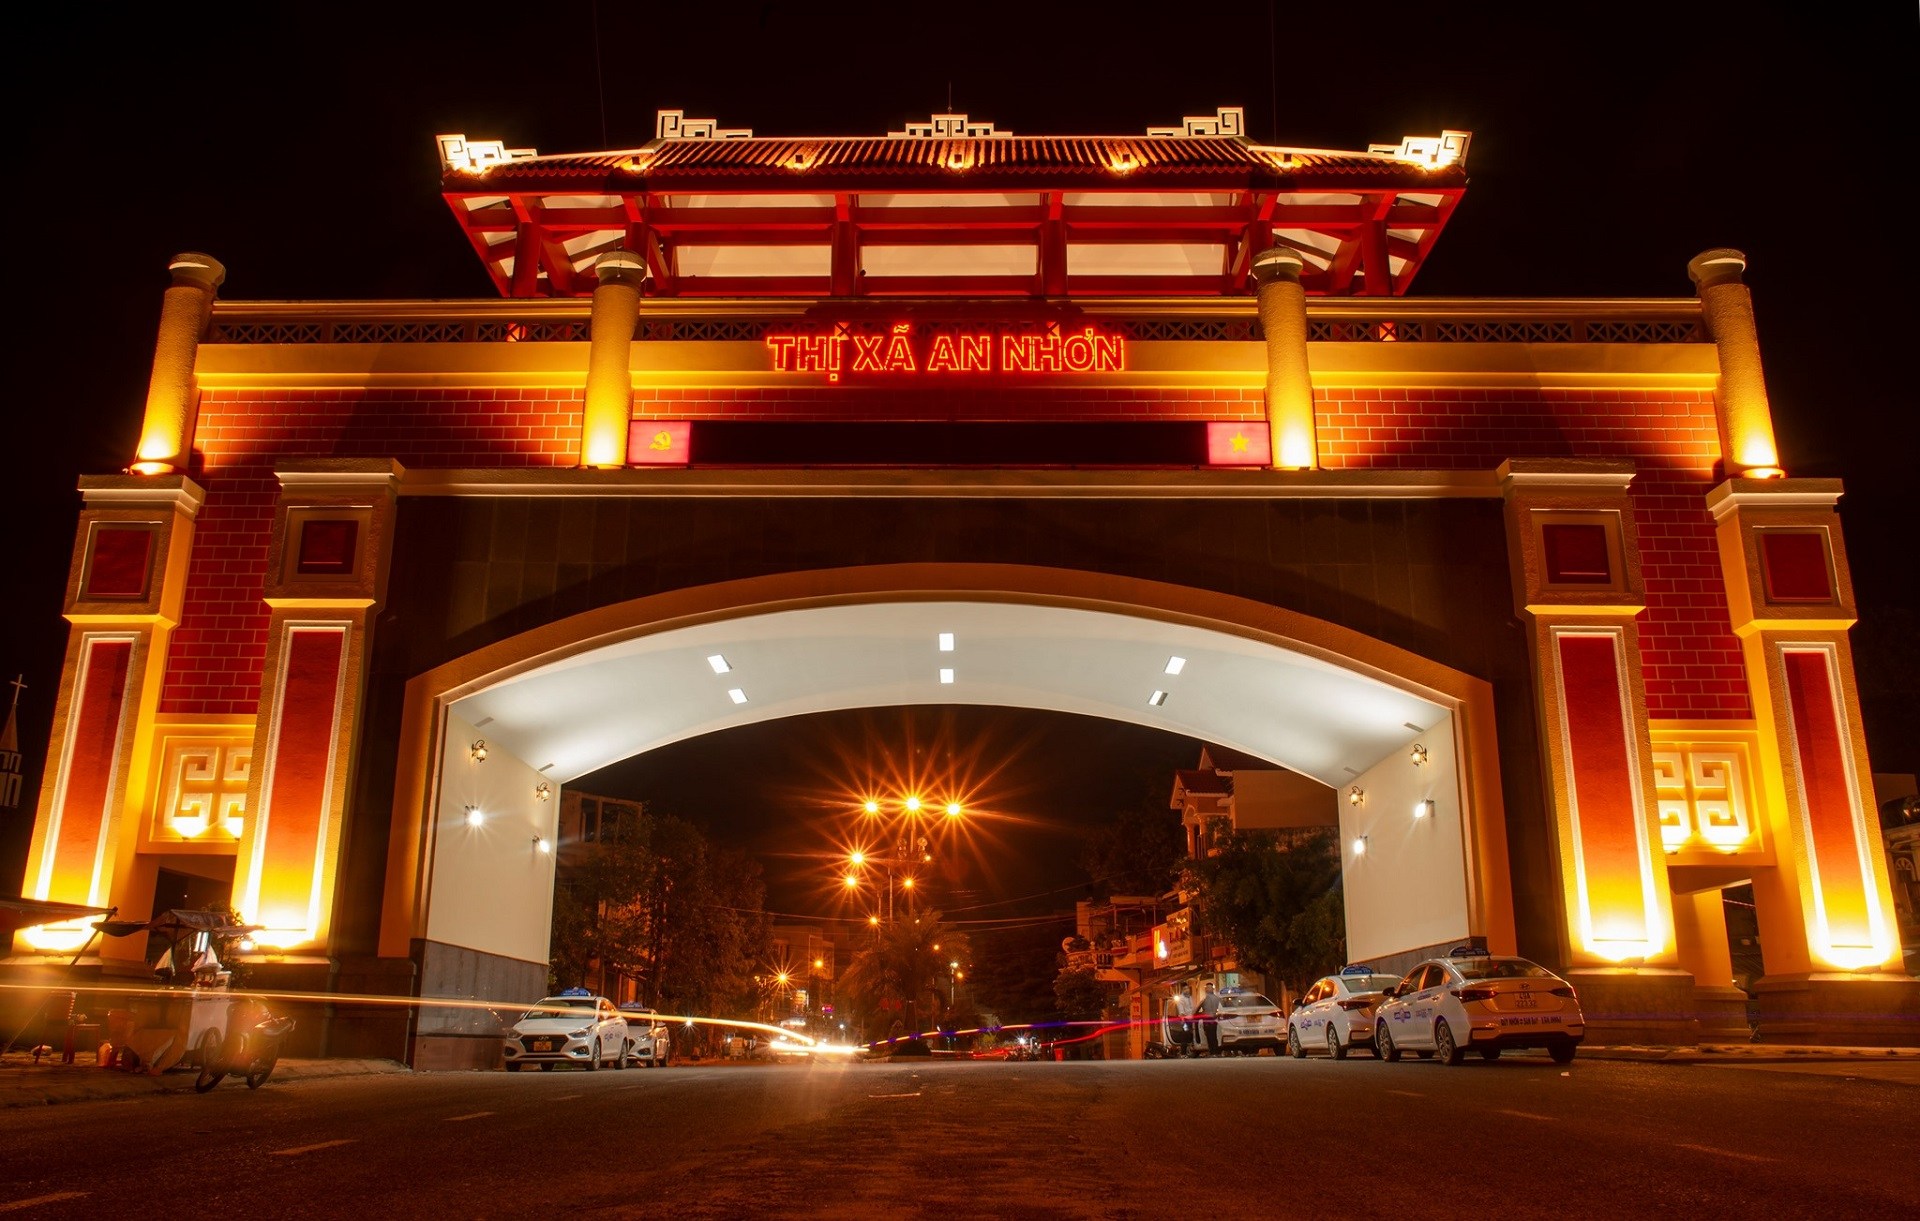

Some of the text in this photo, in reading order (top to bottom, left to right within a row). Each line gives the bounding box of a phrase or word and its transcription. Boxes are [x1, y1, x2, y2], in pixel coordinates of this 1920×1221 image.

[766, 324, 1125, 382] THỊ XÃ AN NHƠN
